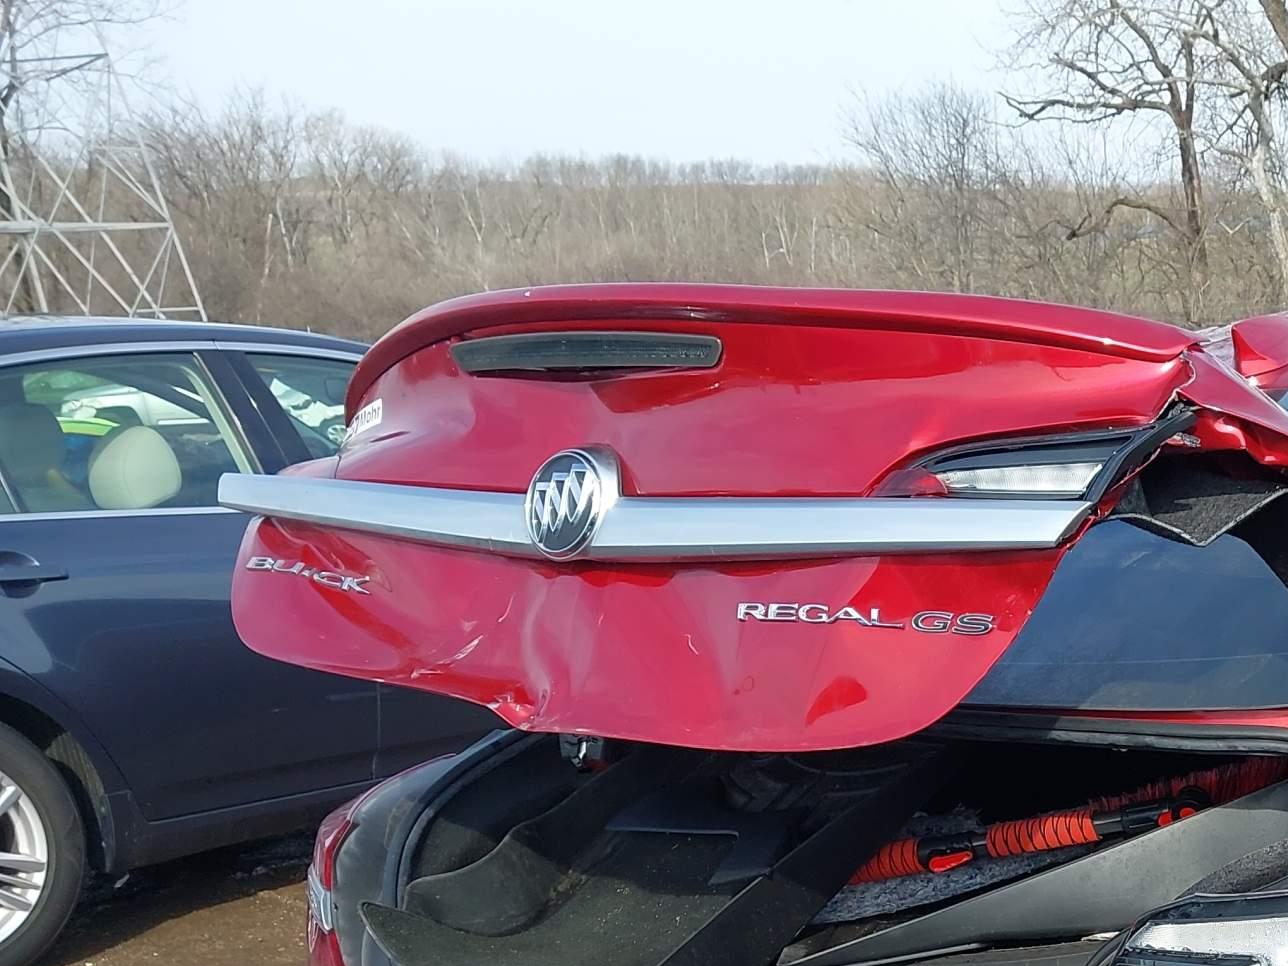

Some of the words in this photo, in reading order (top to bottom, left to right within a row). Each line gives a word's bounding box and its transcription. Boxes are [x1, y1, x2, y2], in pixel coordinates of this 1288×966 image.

[359, 405, 381, 426] Mohr
[246, 556, 370, 595] BUICK
[737, 602, 905, 629] REGAL
[911, 611, 995, 635] GS
